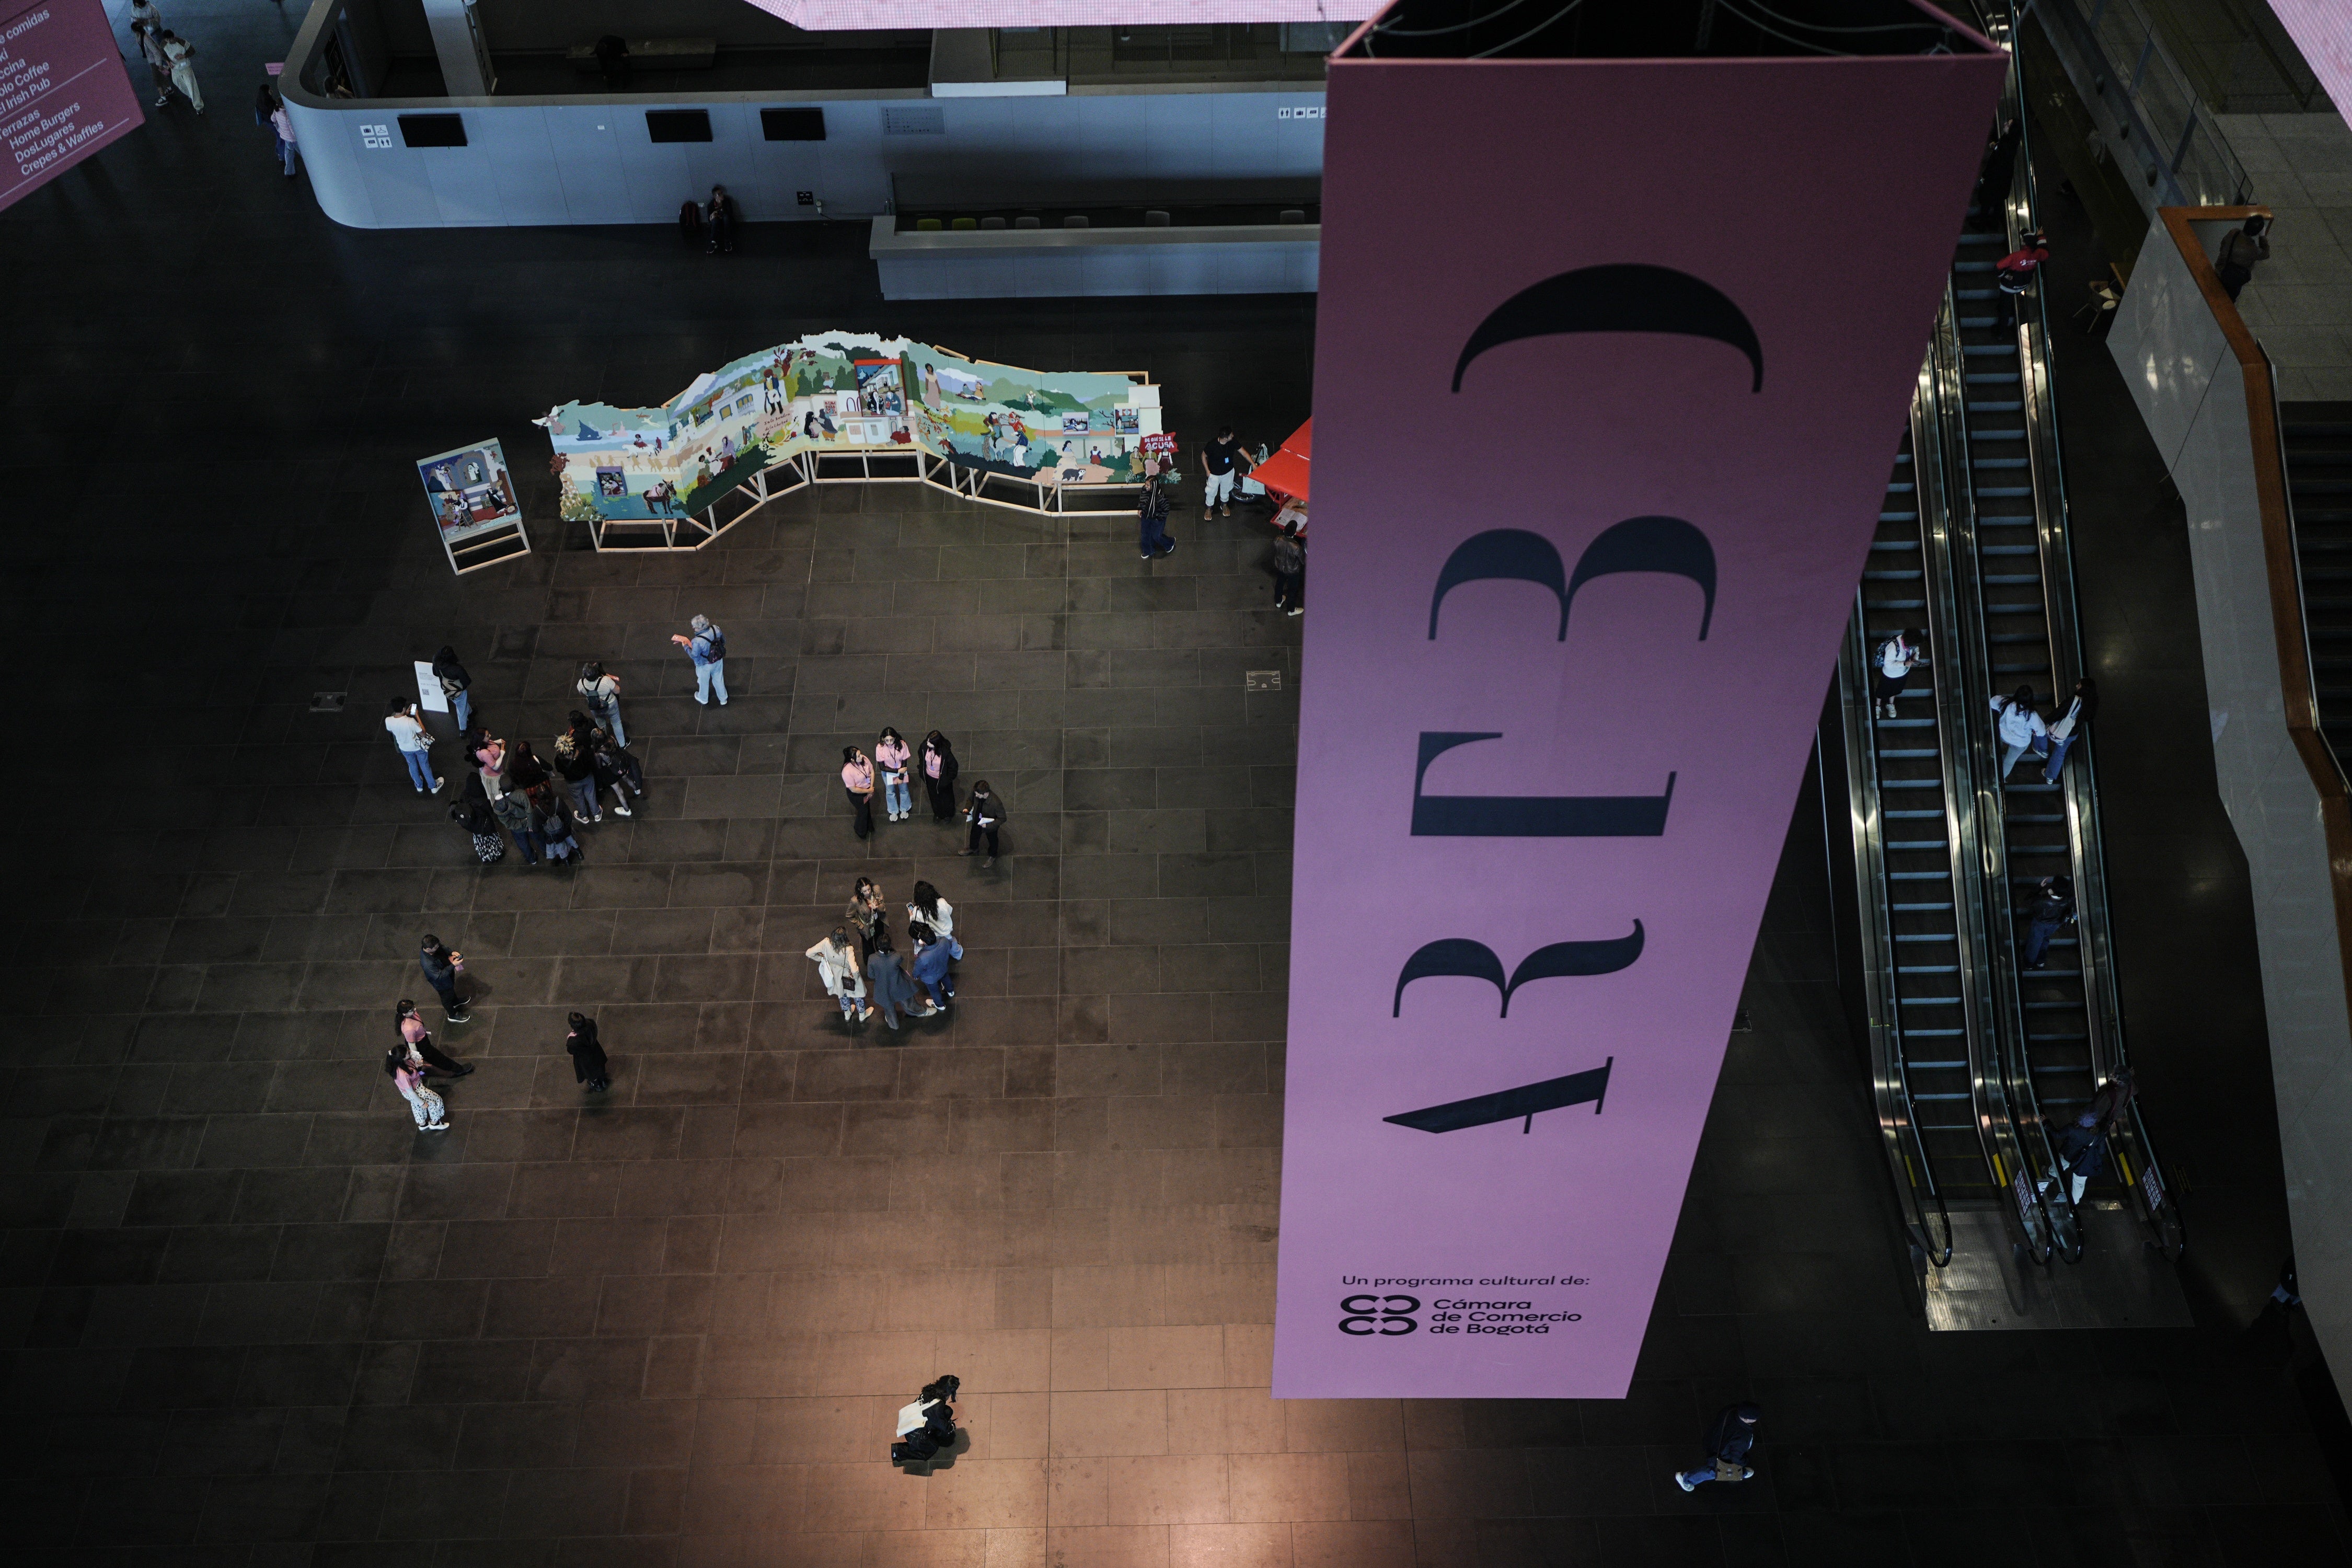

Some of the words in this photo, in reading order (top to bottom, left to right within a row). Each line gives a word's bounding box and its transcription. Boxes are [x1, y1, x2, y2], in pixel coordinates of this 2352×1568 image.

[6, 9, 50, 40] comidas
[0, 47, 9, 62] ki
[0, 58, 26, 79] ccina
[0, 82, 14, 97] olo
[15, 62, 50, 86] Coffee
[5, 89, 30, 110] Irish
[29, 77, 50, 96] Pub
[9, 126, 41, 150] Home
[40, 102, 80, 131] Burgers
[15, 122, 75, 163] DosLugares
[21, 149, 57, 176] Crepes
[57, 142, 67, 154] &
[65, 121, 104, 148] Waffles
[1342, 1275, 1369, 1285] Un
[1374, 1276, 1473, 1287] programa
[1479, 1275, 1555, 1285] cultural
[1560, 1275, 1590, 1285] de:
[1432, 1311, 1461, 1321] de
[1468, 1311, 1582, 1321] Comercio
[1433, 1299, 1532, 1309] Cámara
[1429, 1323, 1459, 1333] de
[1466, 1323, 1550, 1335] Bogotá
